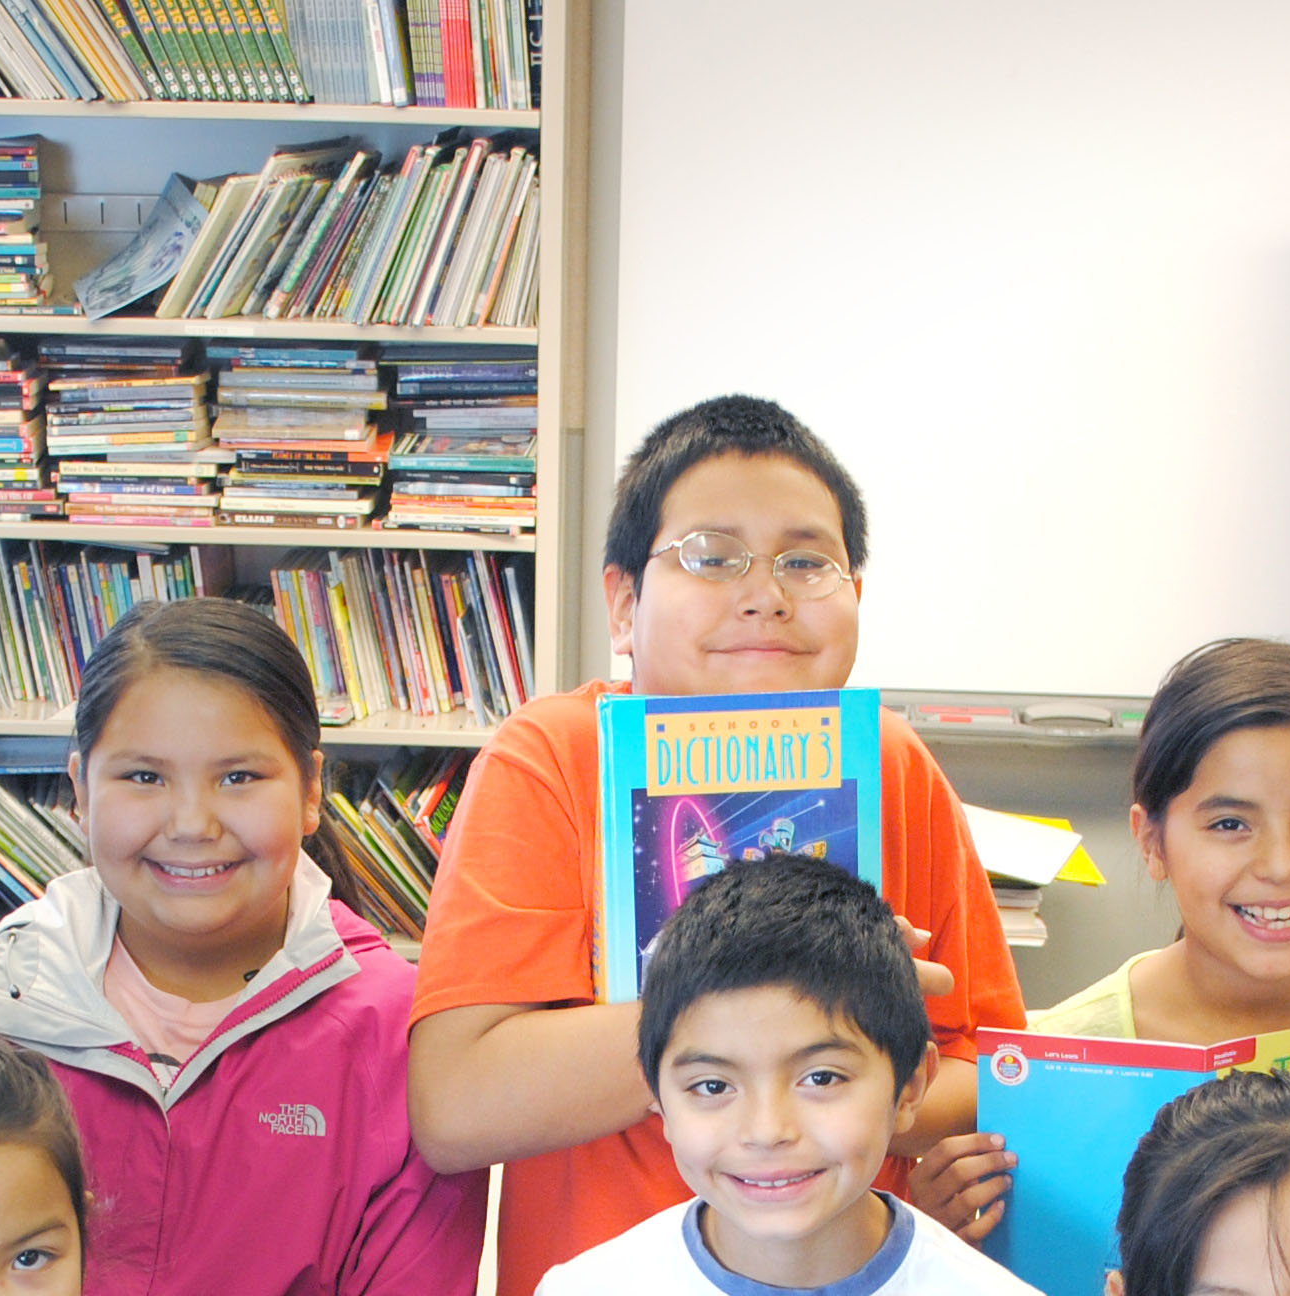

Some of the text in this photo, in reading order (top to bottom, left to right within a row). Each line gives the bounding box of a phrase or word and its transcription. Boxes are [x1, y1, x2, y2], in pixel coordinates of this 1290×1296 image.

[689, 720, 800, 732] SCHOOL
[657, 732, 833, 786] DICTIONARY 3
[279, 1104, 305, 1115] THE
[259, 1112, 304, 1125] NORTH
[271, 1124, 303, 1136] FACE
